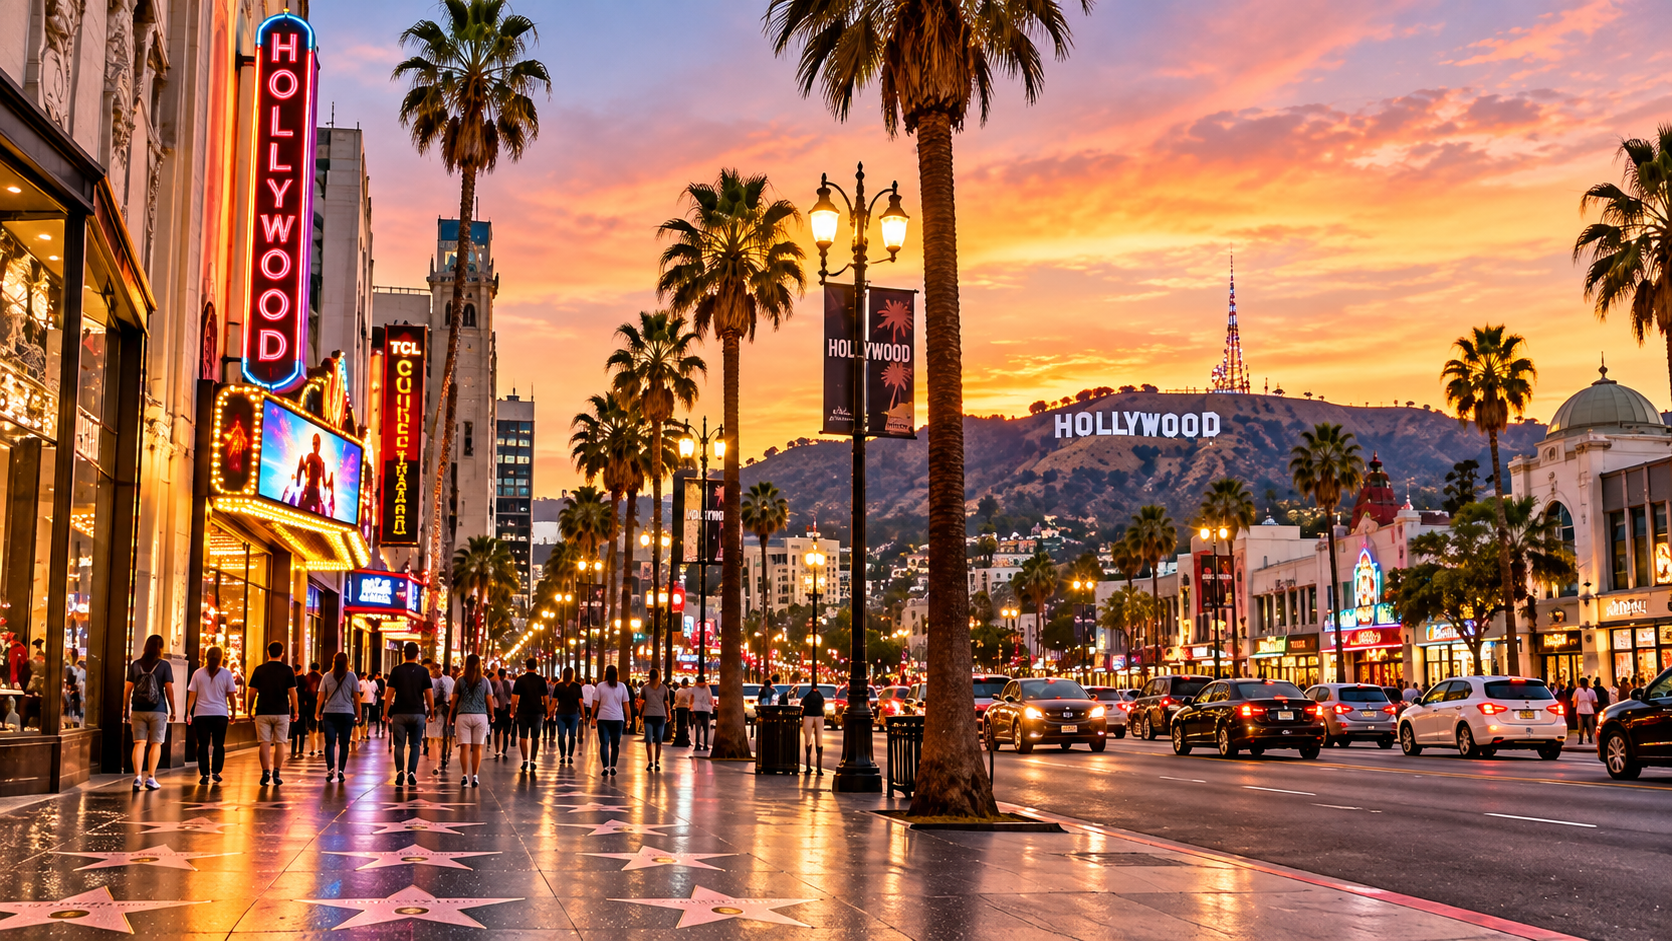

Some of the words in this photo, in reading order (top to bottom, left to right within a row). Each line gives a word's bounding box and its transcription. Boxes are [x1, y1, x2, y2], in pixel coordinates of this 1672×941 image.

[259, 32, 299, 361] HOLLYWOOD
[389, 340, 422, 356] TCL
[828, 338, 911, 363] HOLYWOOD
[1054, 411, 1221, 438] HOLLYWOOD
